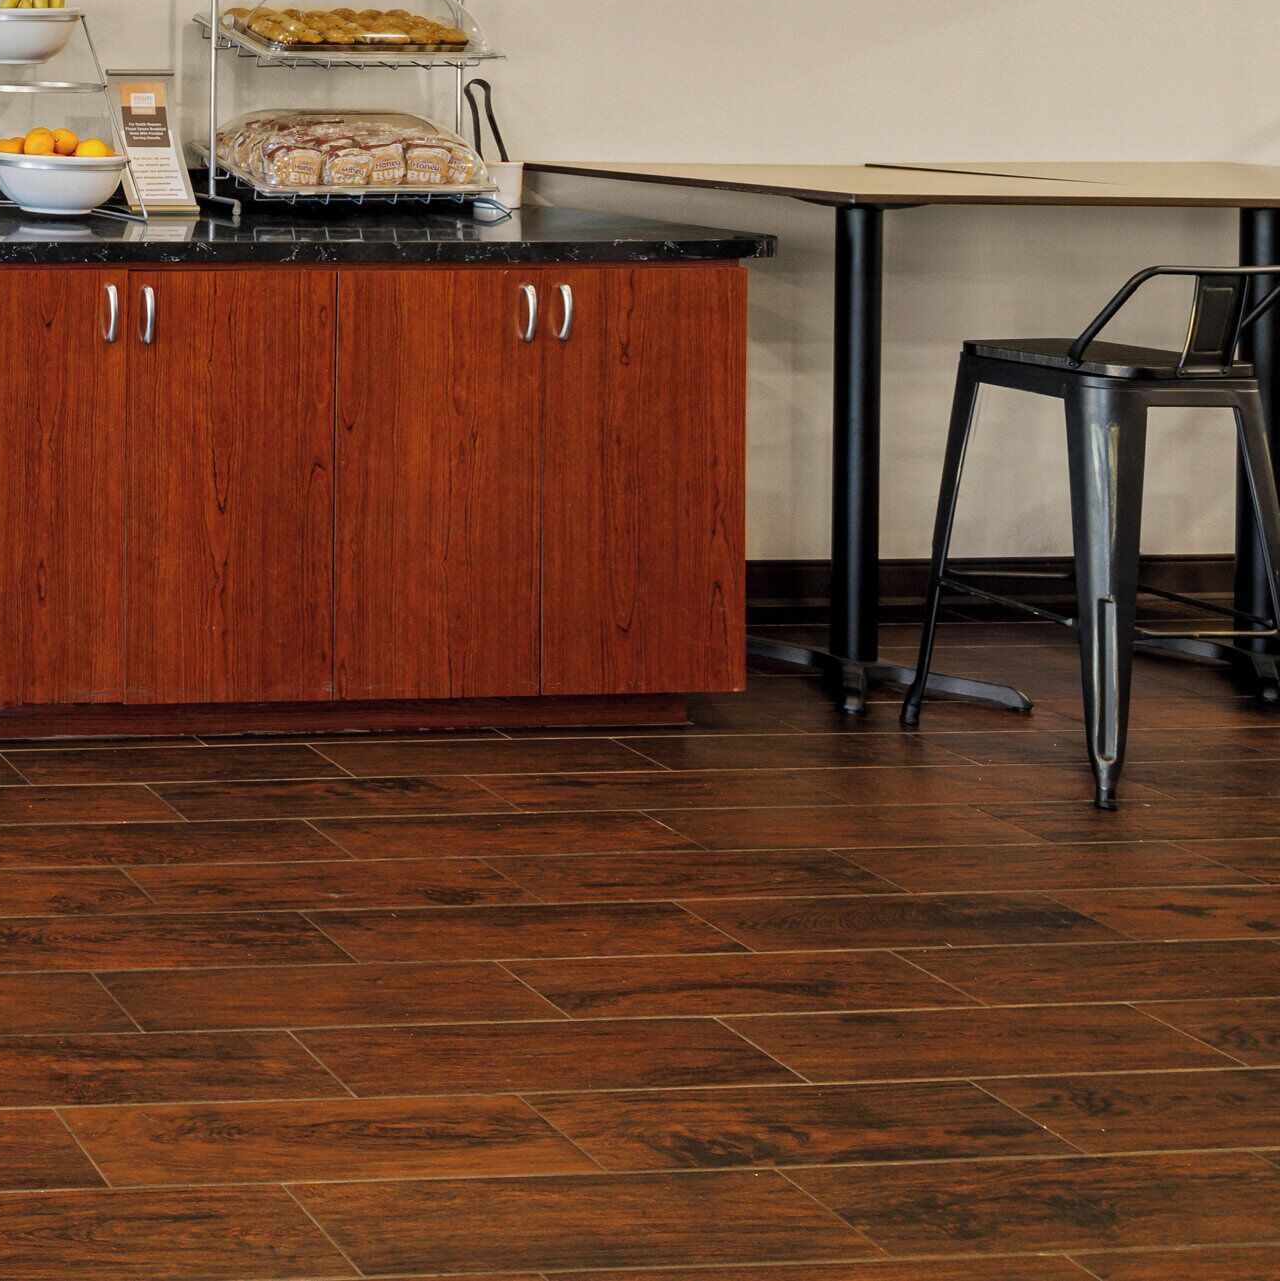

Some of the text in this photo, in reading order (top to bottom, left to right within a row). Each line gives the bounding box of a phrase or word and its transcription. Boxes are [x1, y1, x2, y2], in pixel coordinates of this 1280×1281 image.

[375, 161, 401, 169] Honey
[412, 162, 440, 172] Honey
[372, 168, 404, 182] BUN
[407, 170, 441, 183] BUN
